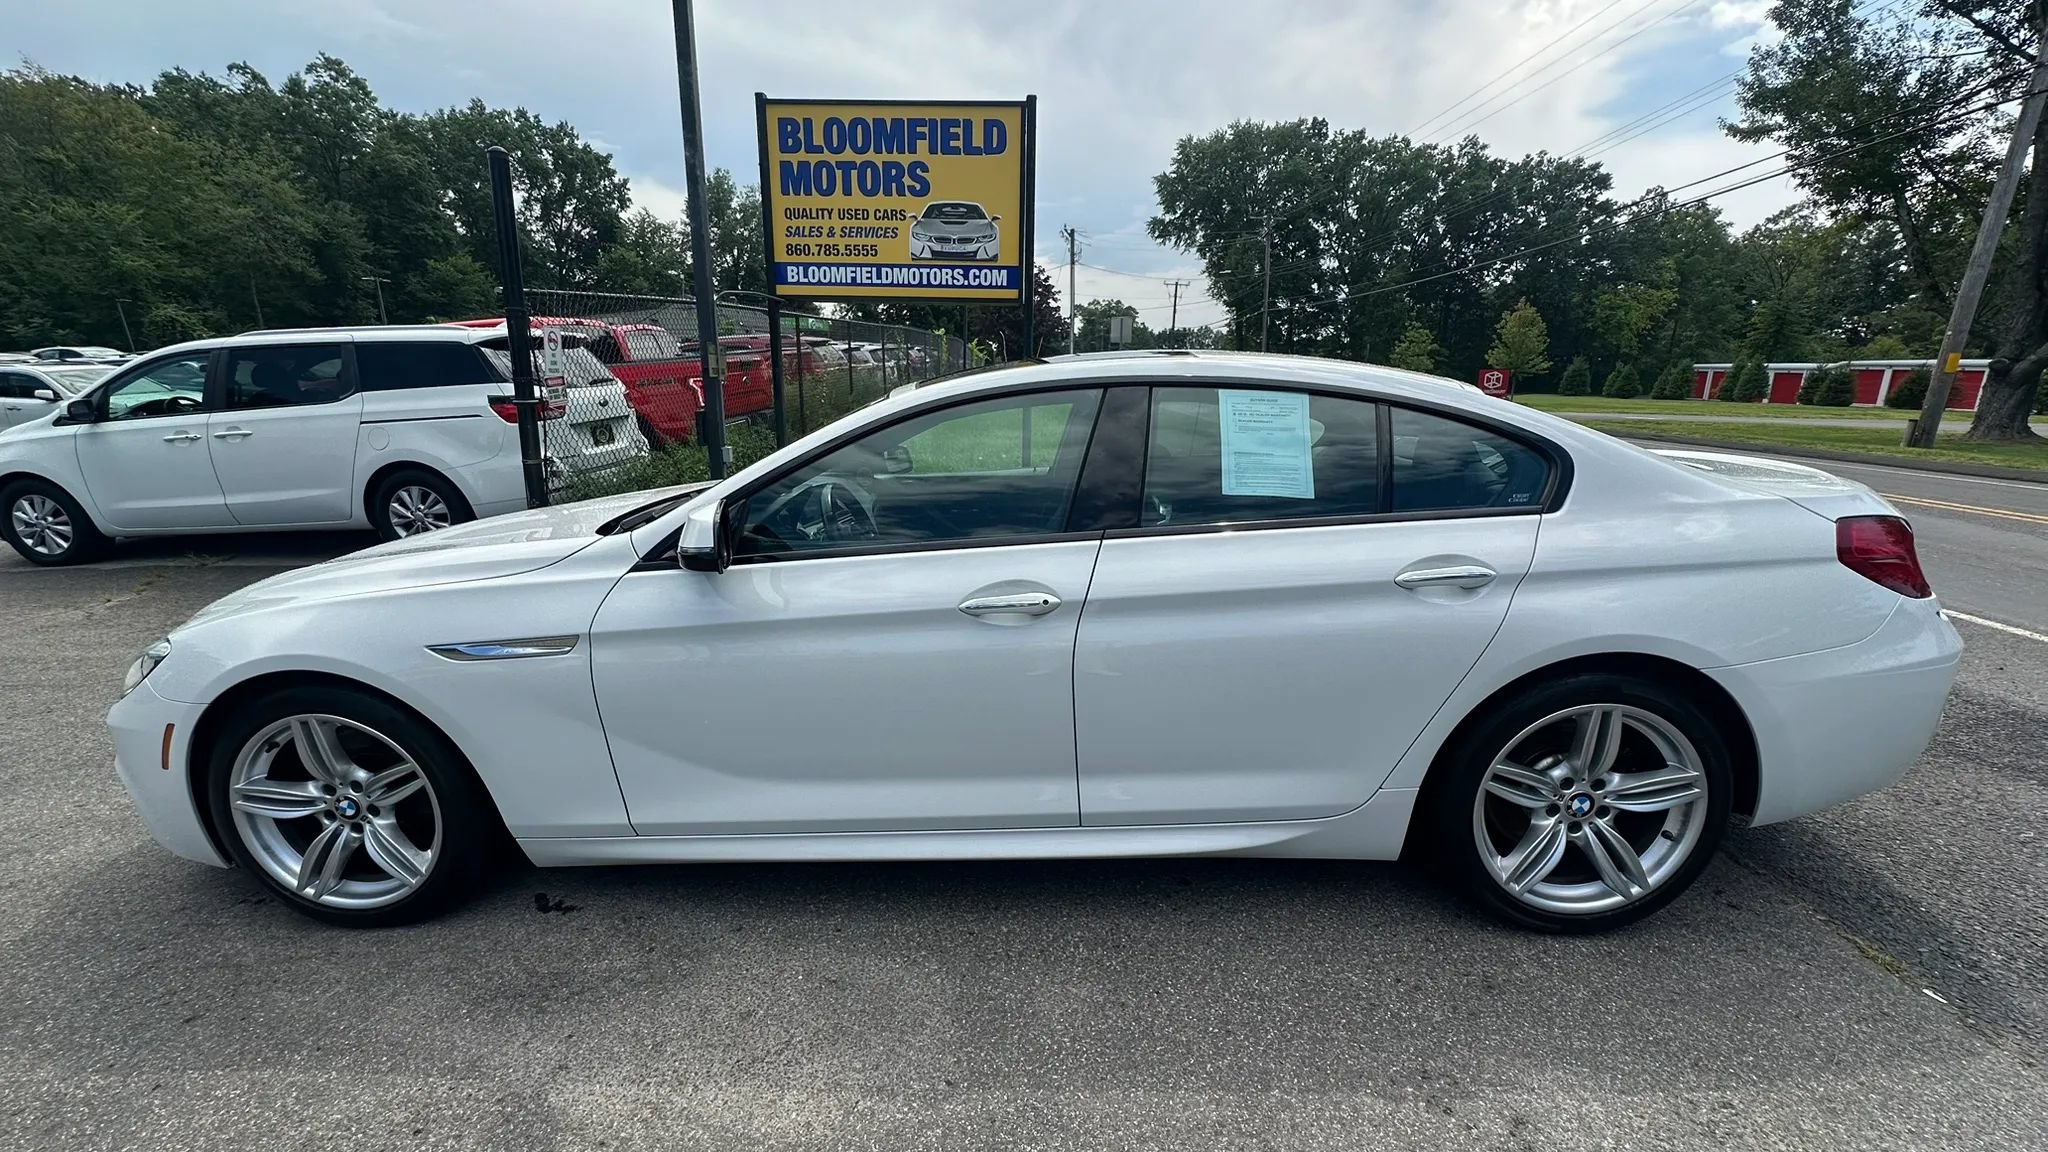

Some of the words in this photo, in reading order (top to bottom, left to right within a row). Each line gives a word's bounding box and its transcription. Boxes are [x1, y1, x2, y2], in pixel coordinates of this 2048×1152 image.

[777, 116, 1007, 155] BLOOMFIELD
[779, 160, 931, 197] MOTORS
[784, 207, 834, 220] QUALITY
[837, 208, 869, 220] USED
[873, 209, 907, 221] CARS
[785, 226, 824, 238] SALES
[826, 226, 836, 238] &
[840, 226, 899, 239] SERVICES
[785, 243, 878, 257] 860.785.5555
[787, 265, 1007, 286] BLOOMFIELDMOTORS.COM
